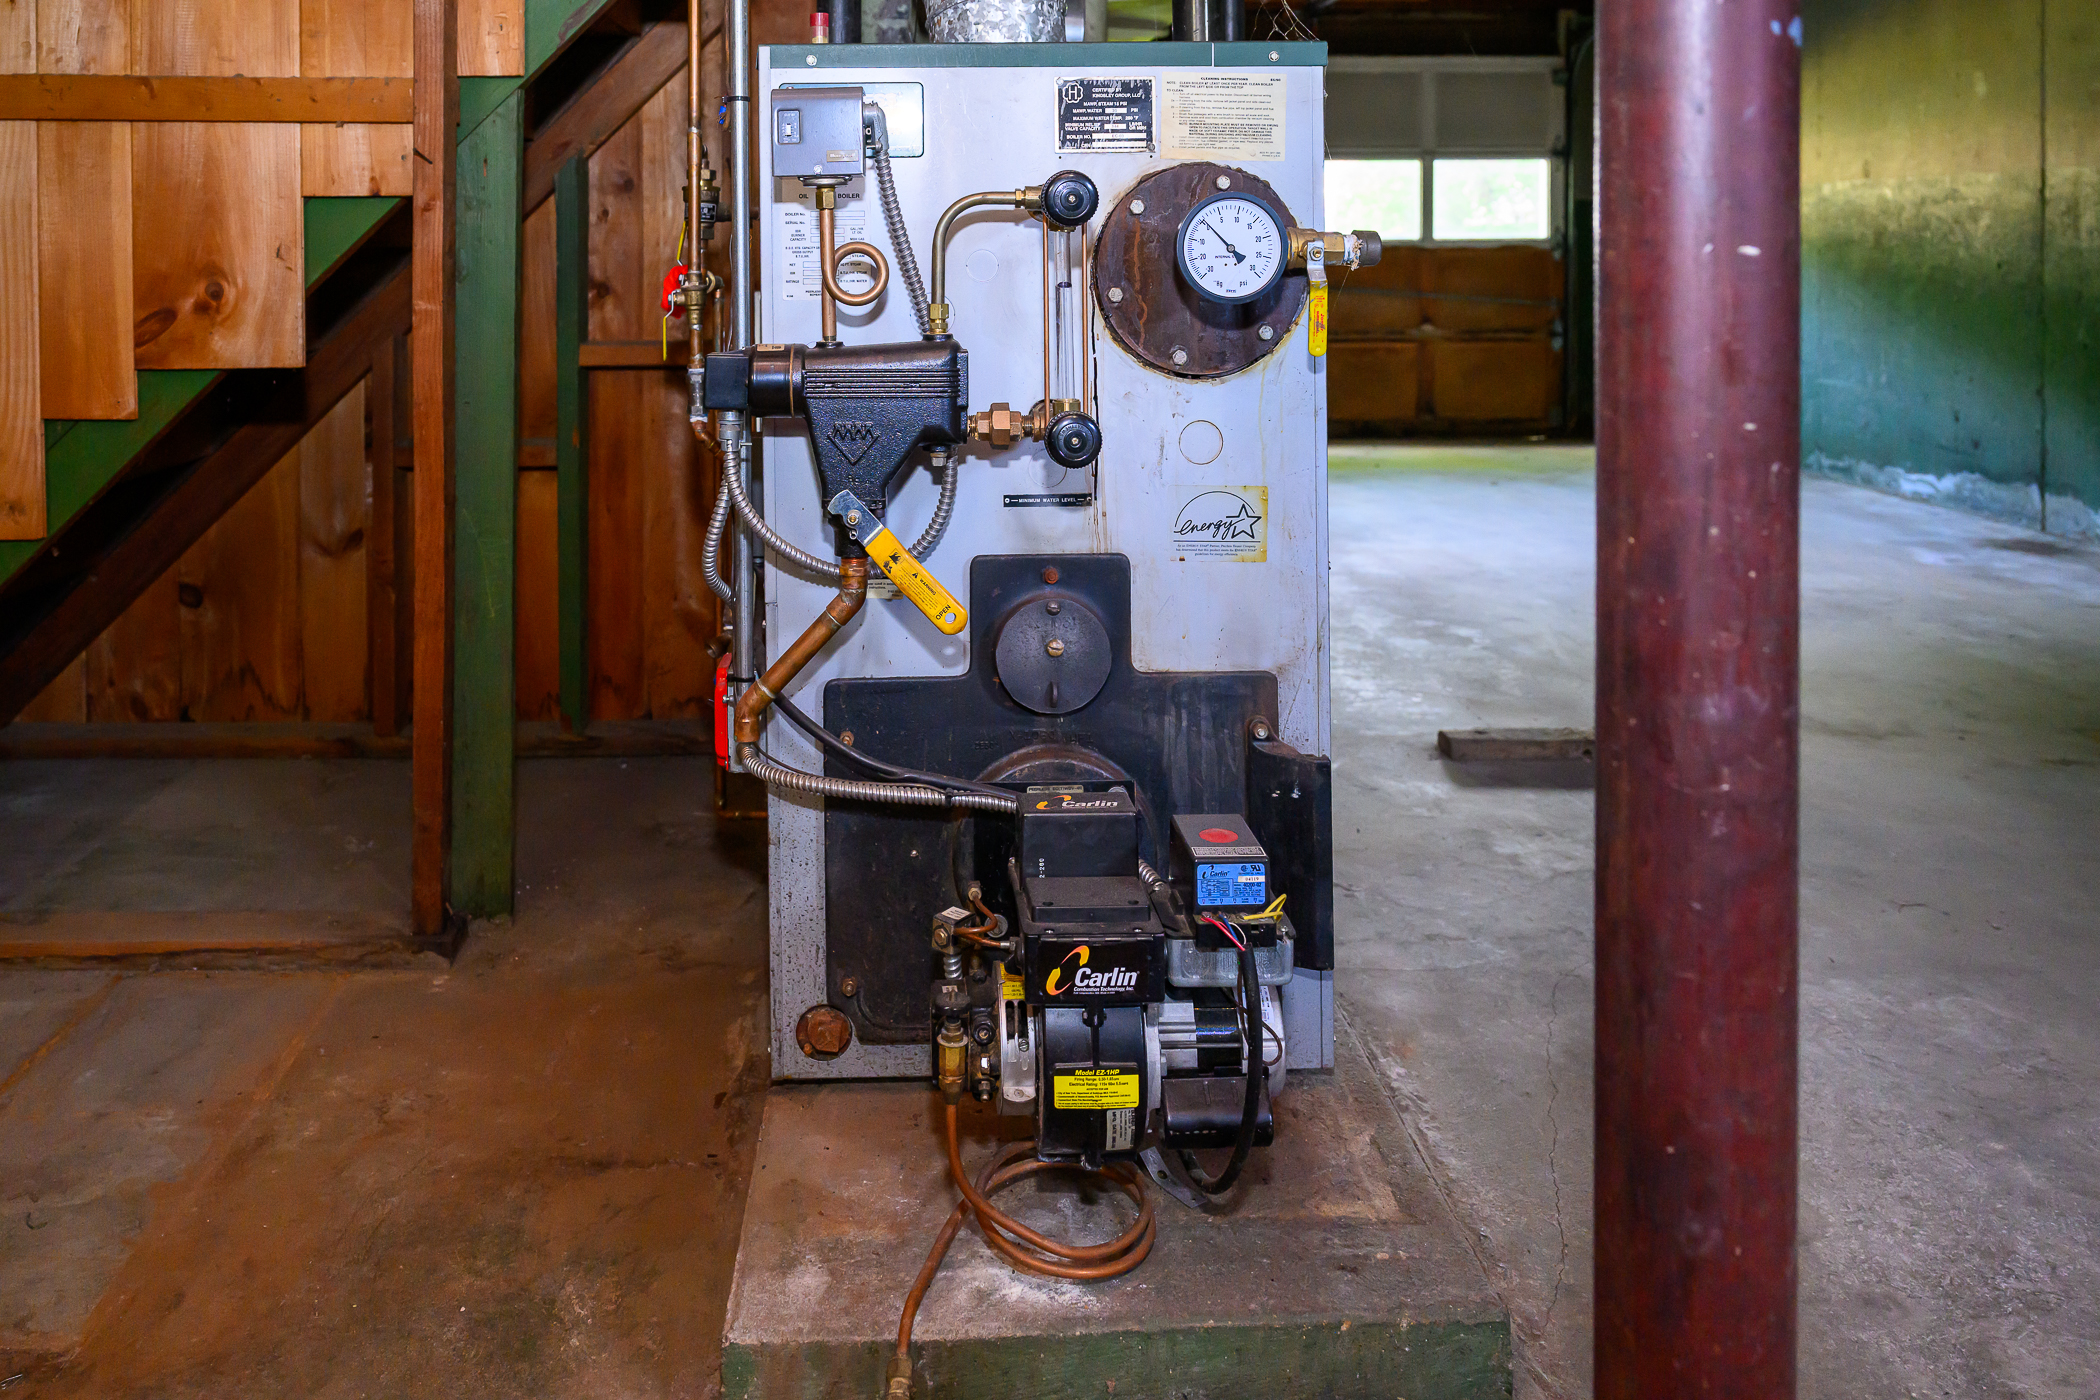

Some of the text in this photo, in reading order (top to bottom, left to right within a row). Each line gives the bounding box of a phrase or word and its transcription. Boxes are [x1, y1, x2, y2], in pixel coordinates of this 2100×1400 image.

[1174, 518, 1245, 540] energy
[920, 579, 936, 596] WARNING
[936, 604, 951, 620] OPEN
[1074, 967, 1138, 987] Carlin
